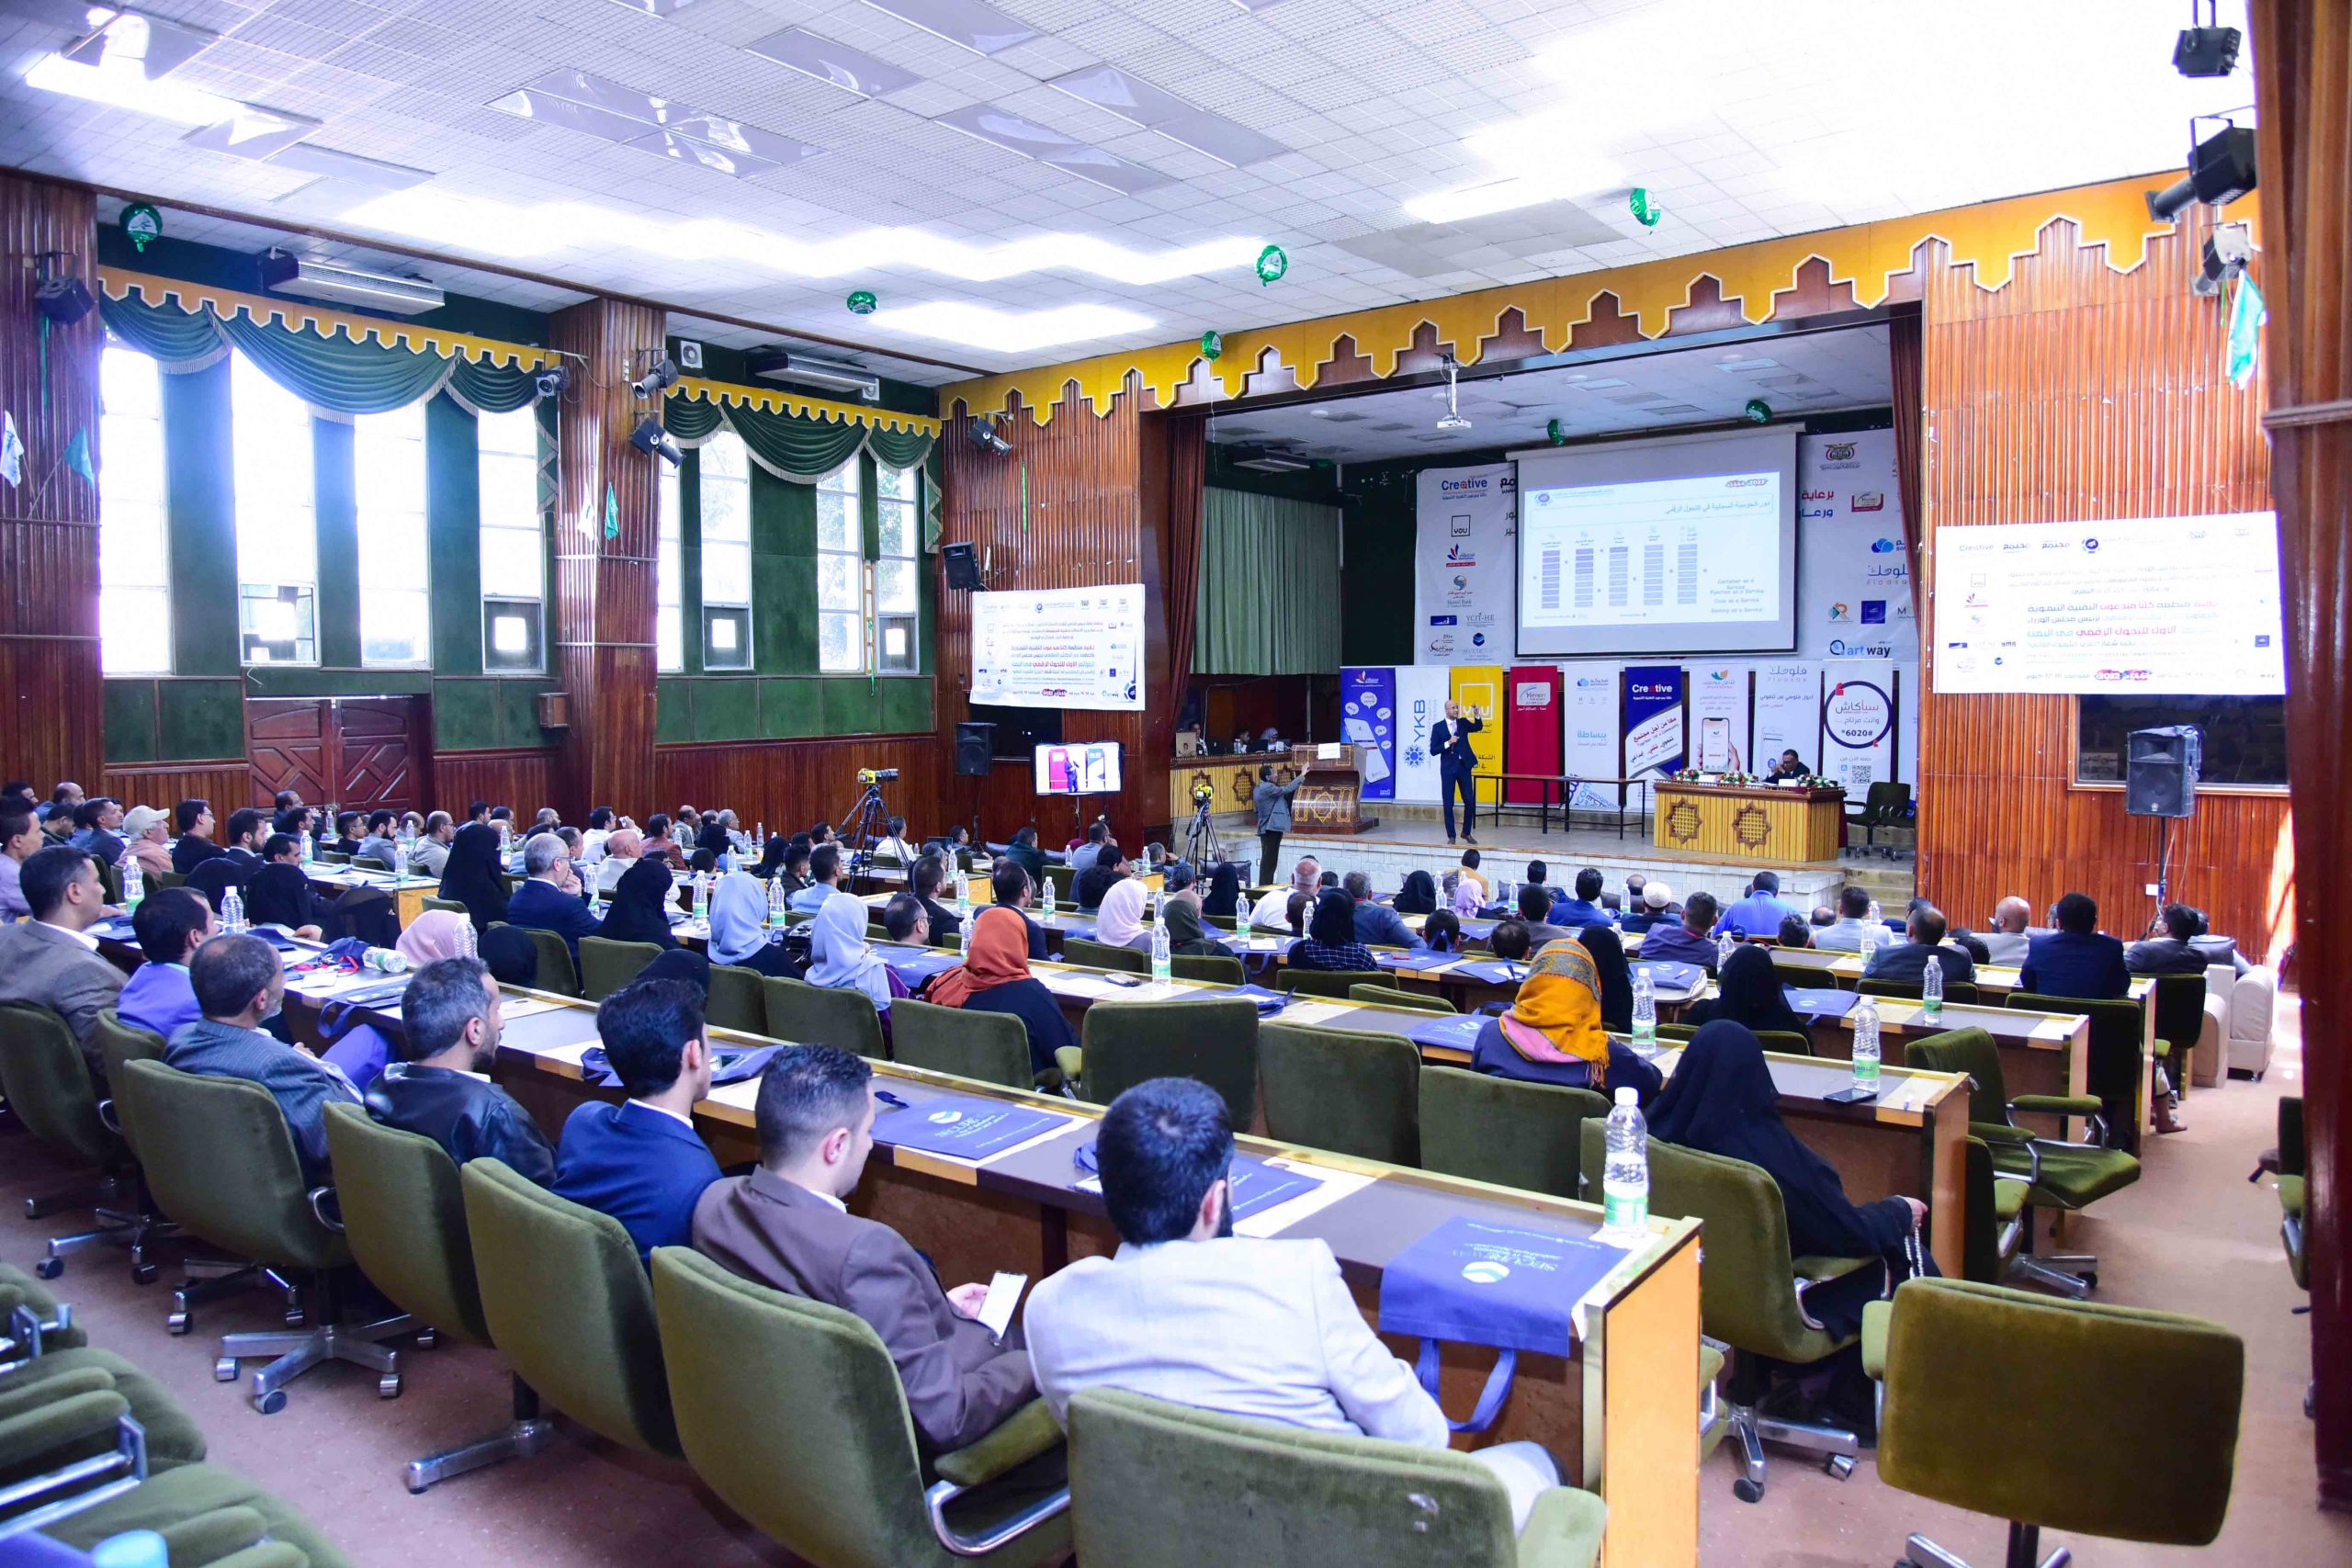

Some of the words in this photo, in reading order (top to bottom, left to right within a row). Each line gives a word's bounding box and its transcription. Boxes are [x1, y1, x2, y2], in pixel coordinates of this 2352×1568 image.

[1442, 479, 1487, 491] Creative
[1867, 646, 1891, 658] way
[1632, 683, 1673, 693] Creative
[1414, 700, 1425, 742] YKB
